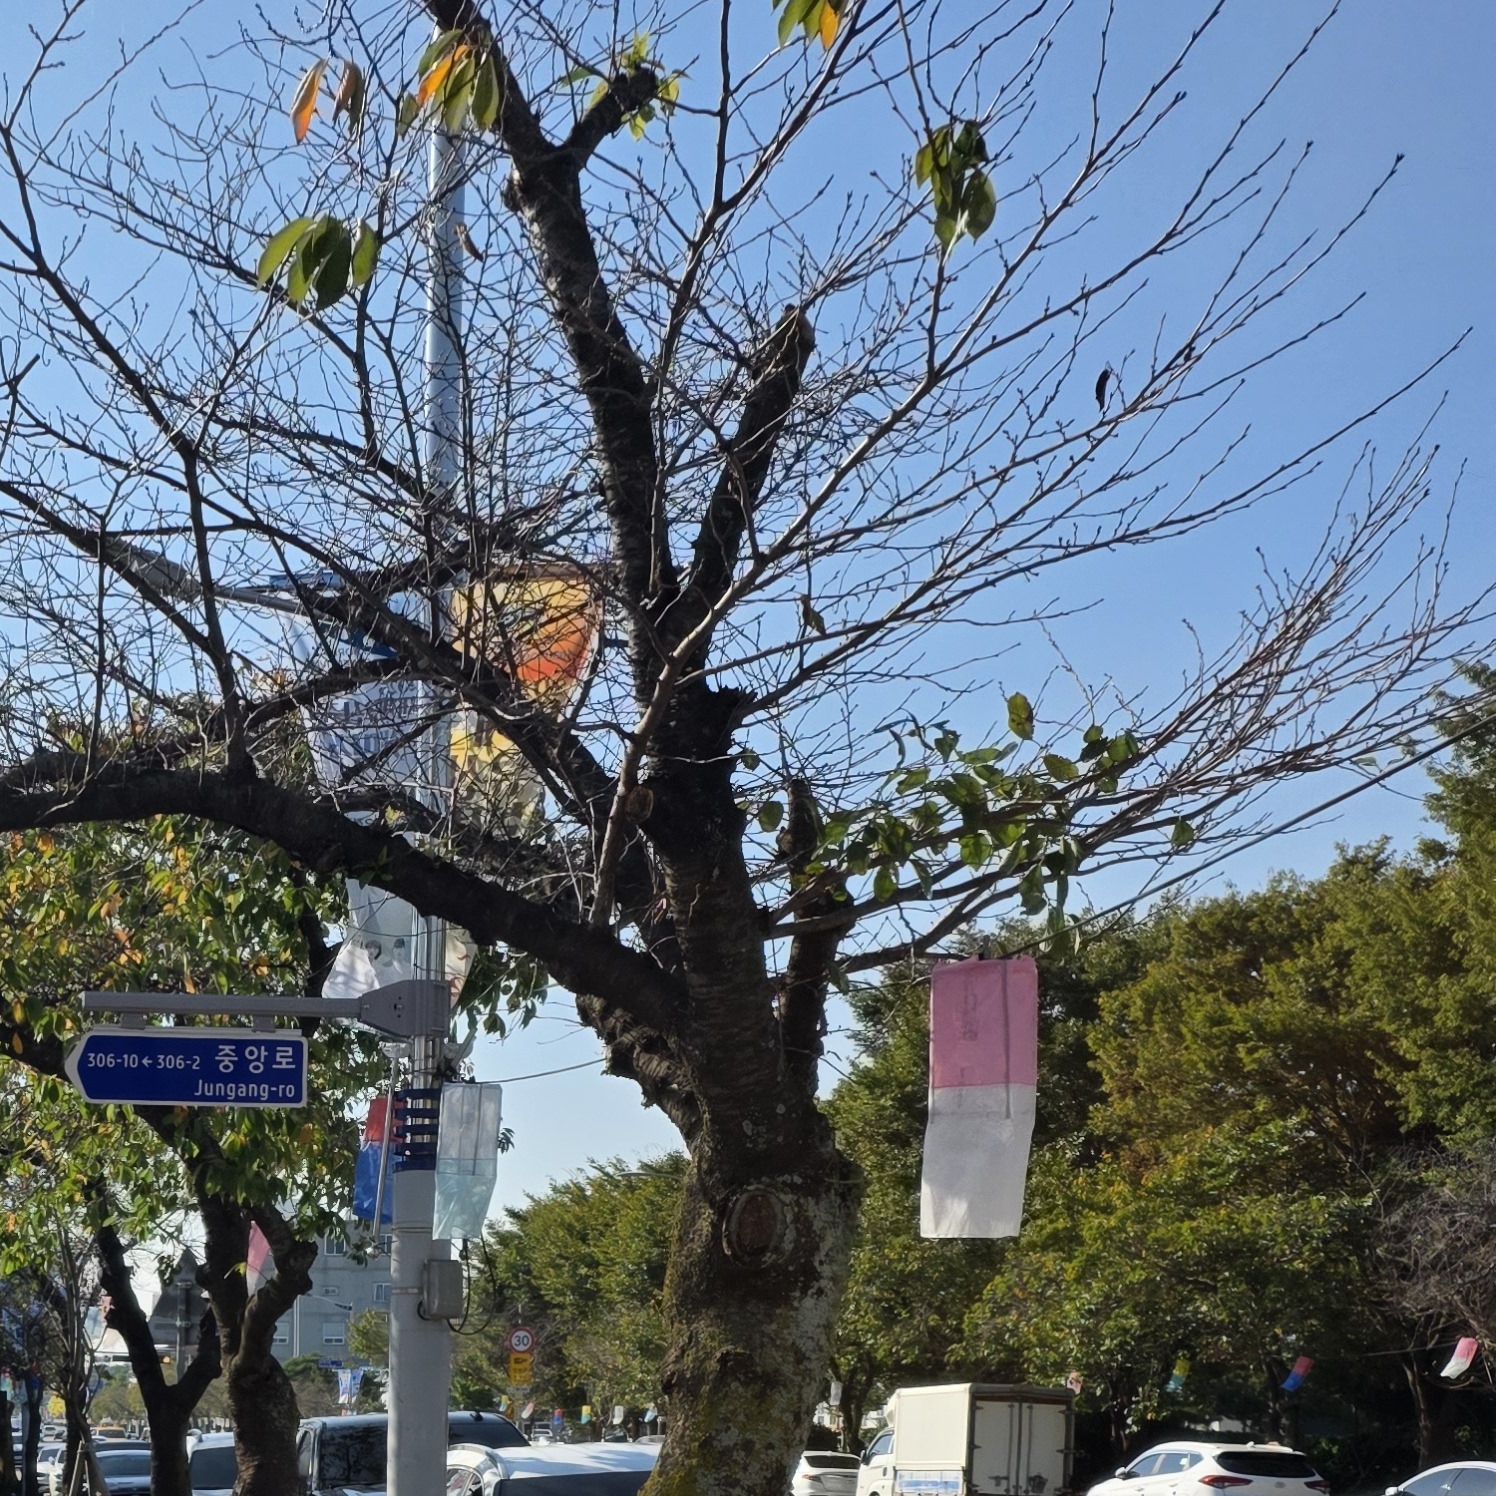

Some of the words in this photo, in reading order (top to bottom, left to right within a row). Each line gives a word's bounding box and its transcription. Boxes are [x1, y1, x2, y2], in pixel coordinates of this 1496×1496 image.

[87, 1052, 139, 1068] 306-10
[156, 1054, 201, 1070] 306-2
[214, 1044, 296, 1074] 중앙로
[193, 1079, 296, 1101] Jungang-ro
[514, 1334, 530, 1347] 30
